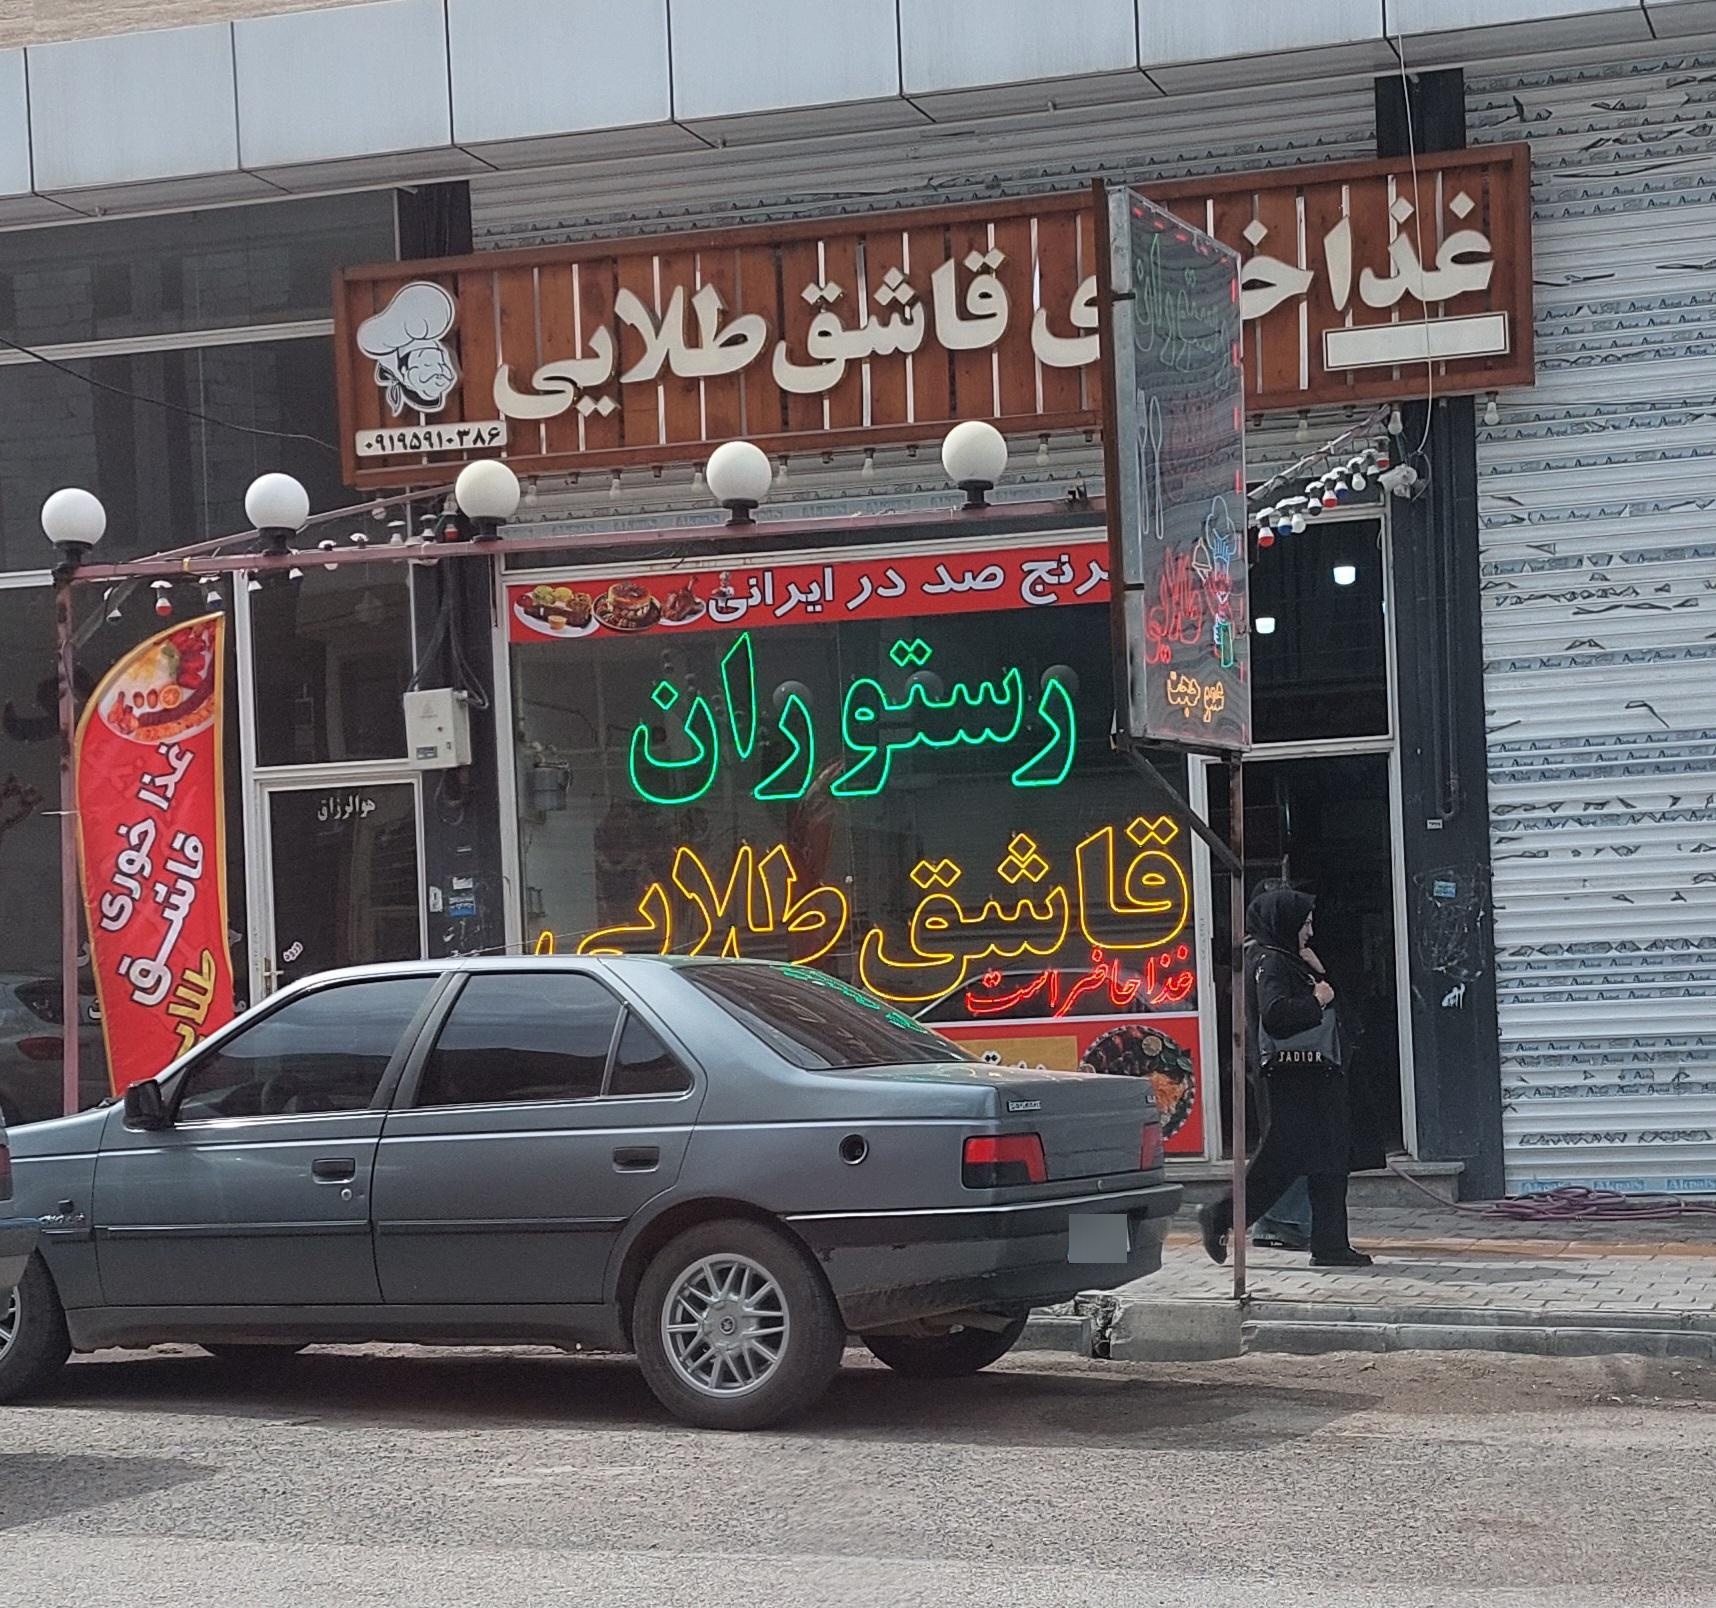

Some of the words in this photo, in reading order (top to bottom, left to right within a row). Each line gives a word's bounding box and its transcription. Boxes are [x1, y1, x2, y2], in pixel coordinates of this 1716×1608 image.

[771, 246, 1010, 394] قاشق
[493, 282, 768, 420] طلایی
[364, 427, 501, 452] ۰۹۱۹۵۹۱۰۳۸۶
[707, 565, 835, 622] ایرانی
[846, 567, 907, 611] در
[922, 562, 1005, 595] صد
[629, 631, 1077, 805] رستوران
[858, 815, 1189, 1001] قاشق
[965, 967, 1060, 1013] است
[1053, 948, 1142, 1018] حاضر
[1151, 945, 1194, 1004] غذا
[166, 948, 217, 1065] طلای
[1278, 1050, 1323, 1063] JADIOR
